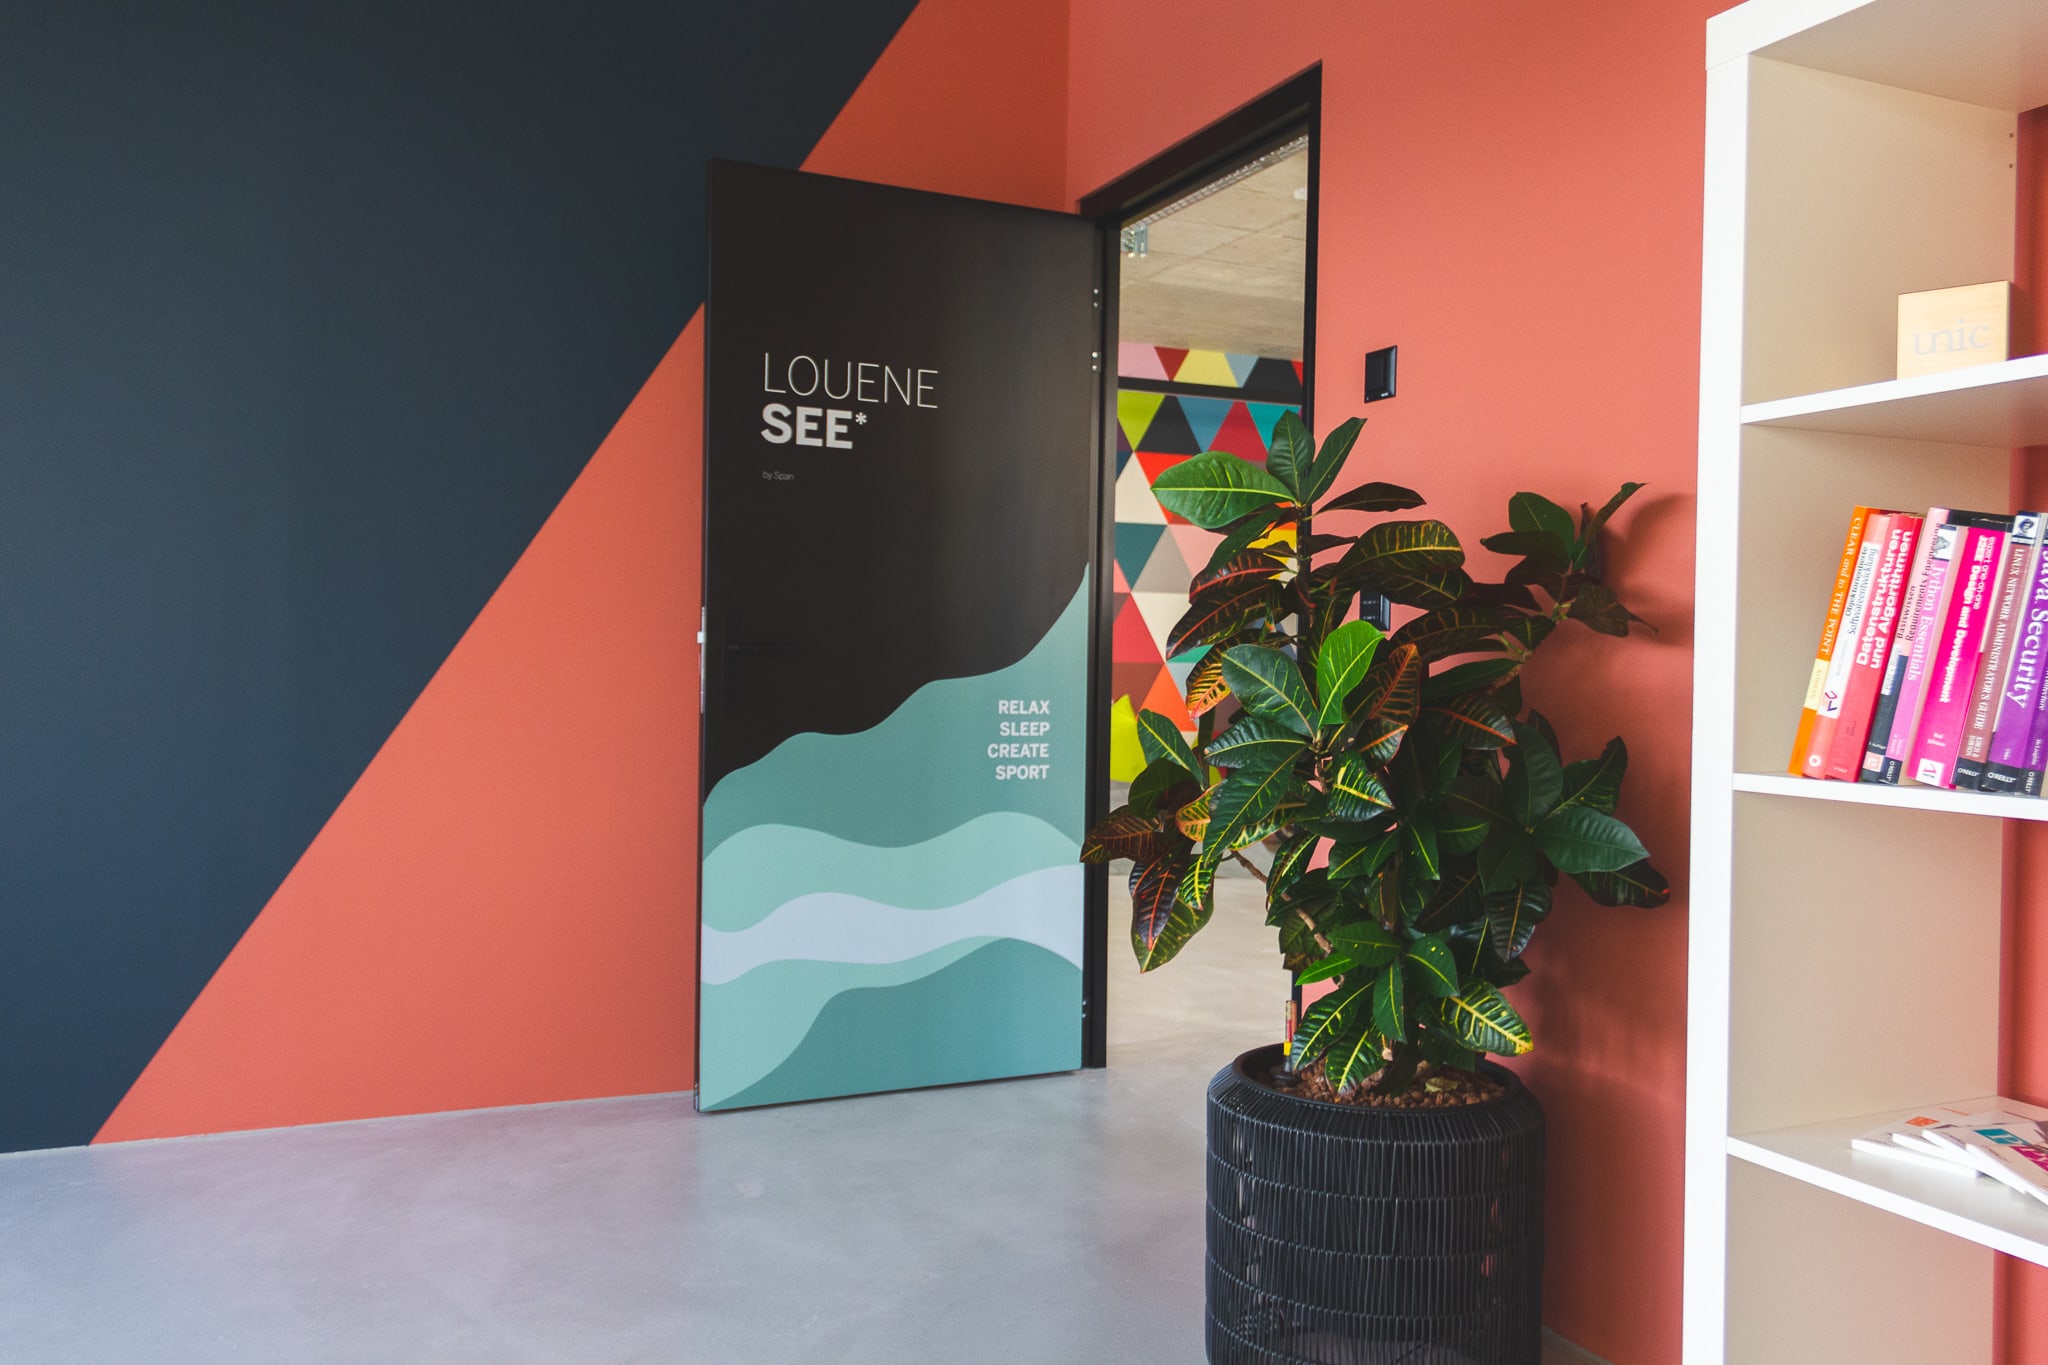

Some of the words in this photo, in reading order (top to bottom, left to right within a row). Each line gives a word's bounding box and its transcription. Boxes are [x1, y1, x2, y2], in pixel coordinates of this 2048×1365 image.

[1912, 317, 1991, 356] unic
[764, 352, 939, 409] LOUENE
[762, 471, 772, 481] by
[774, 471, 795, 481] Span
[1846, 517, 1861, 556] CLEAR
[1840, 558, 1850, 578] and
[2010, 548, 2025, 575] LINUX
[1838, 579, 1846, 589] to
[1845, 546, 1868, 617] Objektorientierte
[1848, 548, 1879, 636] Softwareentwicklung
[1856, 528, 1903, 666] Datenstrukturen
[1870, 637, 1886, 669] und
[1878, 530, 1913, 635] Algorithmen
[1924, 563, 1946, 611] Jython
[1963, 565, 1981, 605] Design
[1999, 577, 2018, 621] NETWORK
[1831, 592, 1844, 616] THE
[1896, 585, 1916, 640] Basiswissen
[1905, 580, 1928, 642] Requirements
[1958, 606, 1971, 628] and
[1821, 618, 1837, 656] POINT
[1907, 616, 1934, 681] Essentials
[1939, 629, 1967, 704] Development
[2007, 608, 2048, 709] Security
[998, 700, 1050, 714] RELAX
[1973, 701, 1988, 730] GUIDE
[1000, 722, 1050, 736] SLEEP
[987, 743, 1049, 758] CREATE
[995, 765, 1050, 780] SPORT
